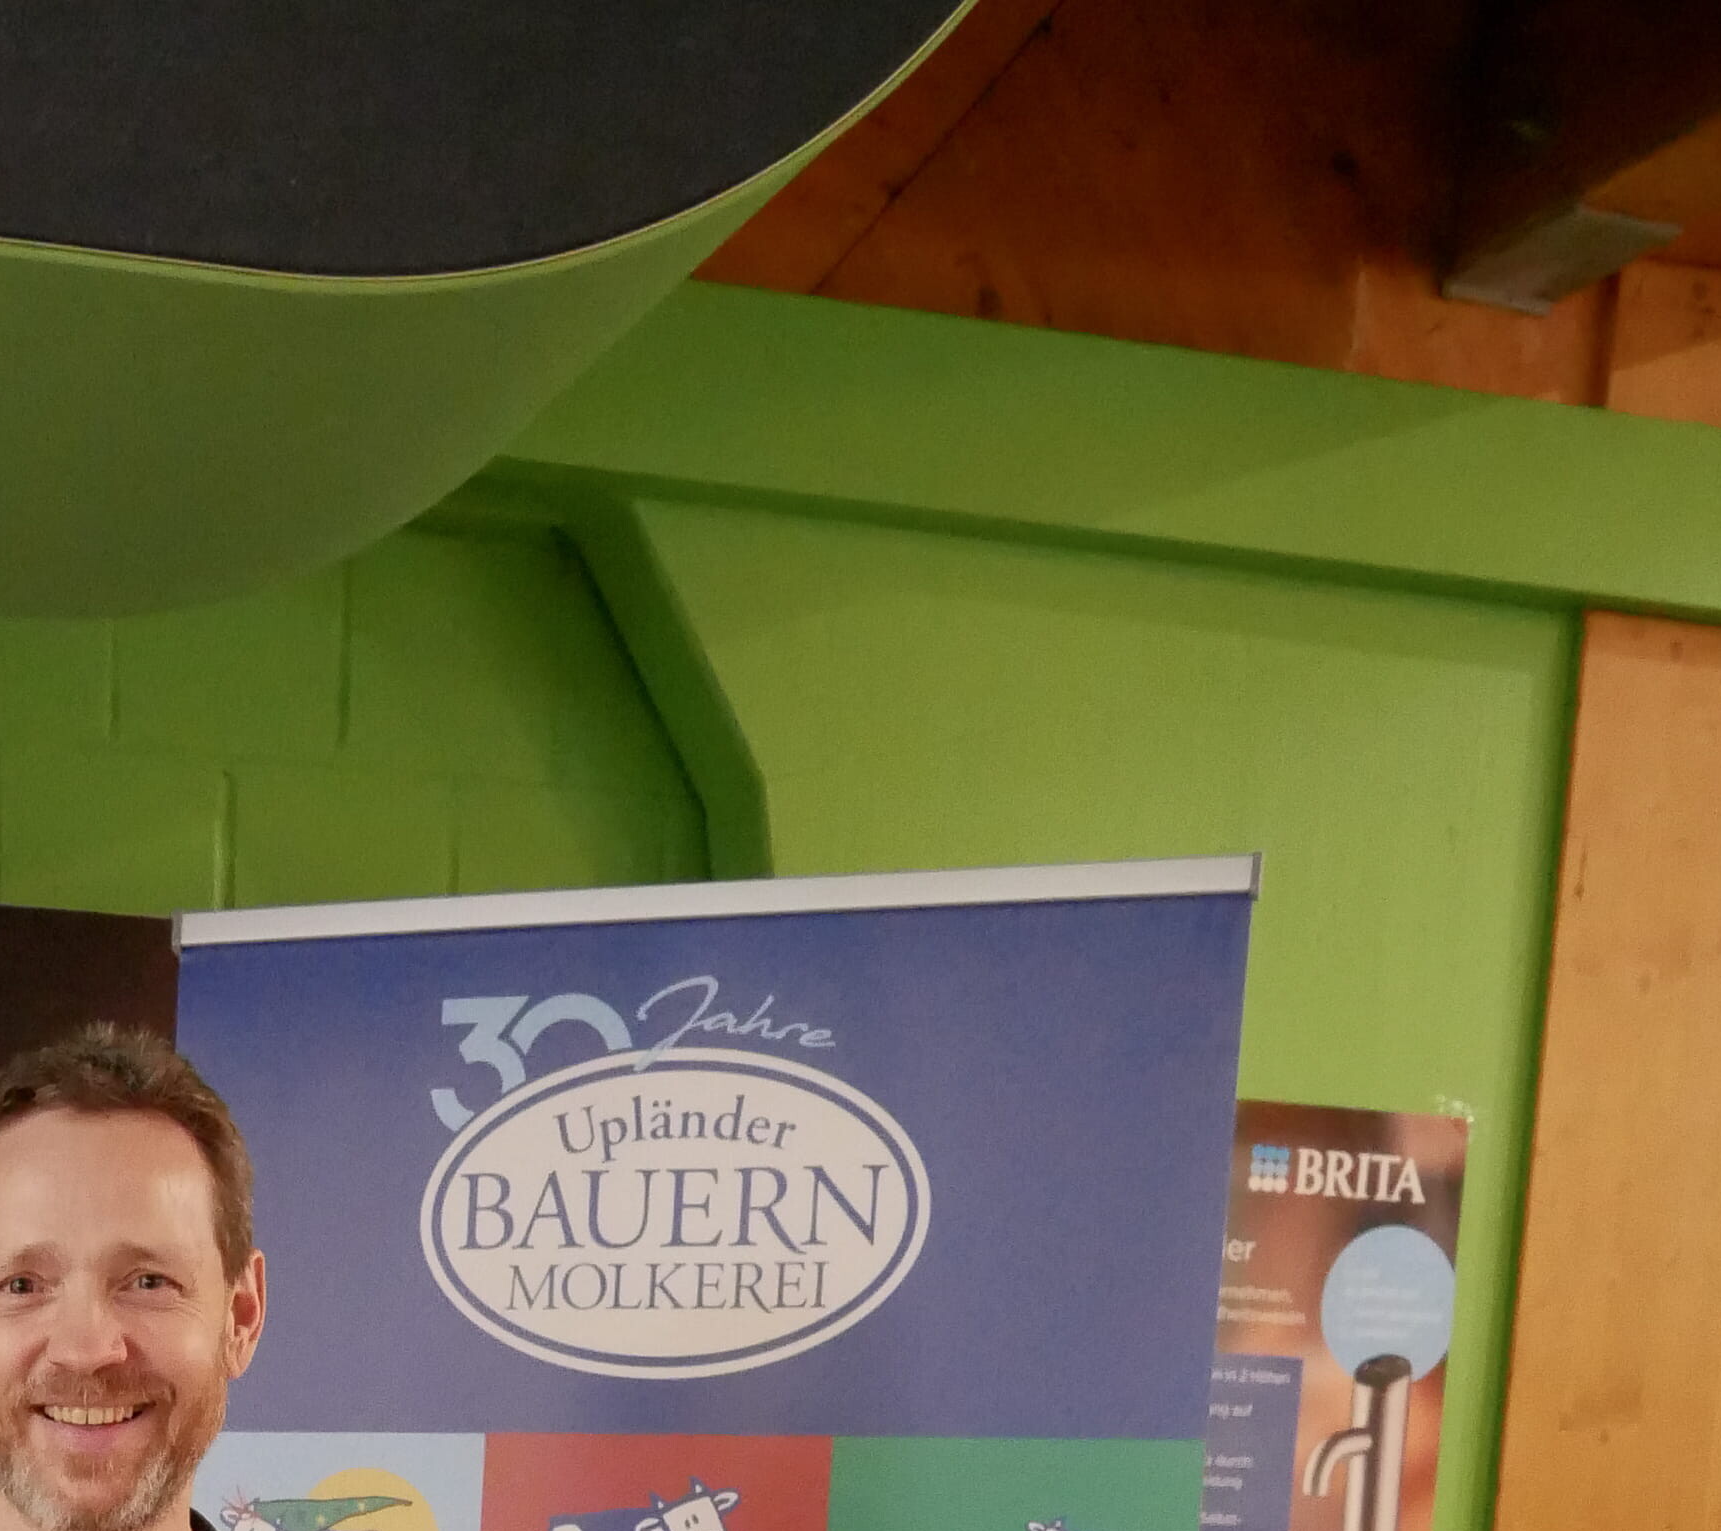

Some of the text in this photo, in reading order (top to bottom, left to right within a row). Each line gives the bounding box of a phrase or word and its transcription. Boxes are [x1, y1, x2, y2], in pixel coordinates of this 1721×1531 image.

[430, 975, 836, 1133] 30 Jahre
[553, 1095, 796, 1163] Upländer
[458, 1164, 888, 1255] BAUERN
[1293, 1148, 1426, 1205] BRITA
[505, 1261, 830, 1314] MOLKEREI
